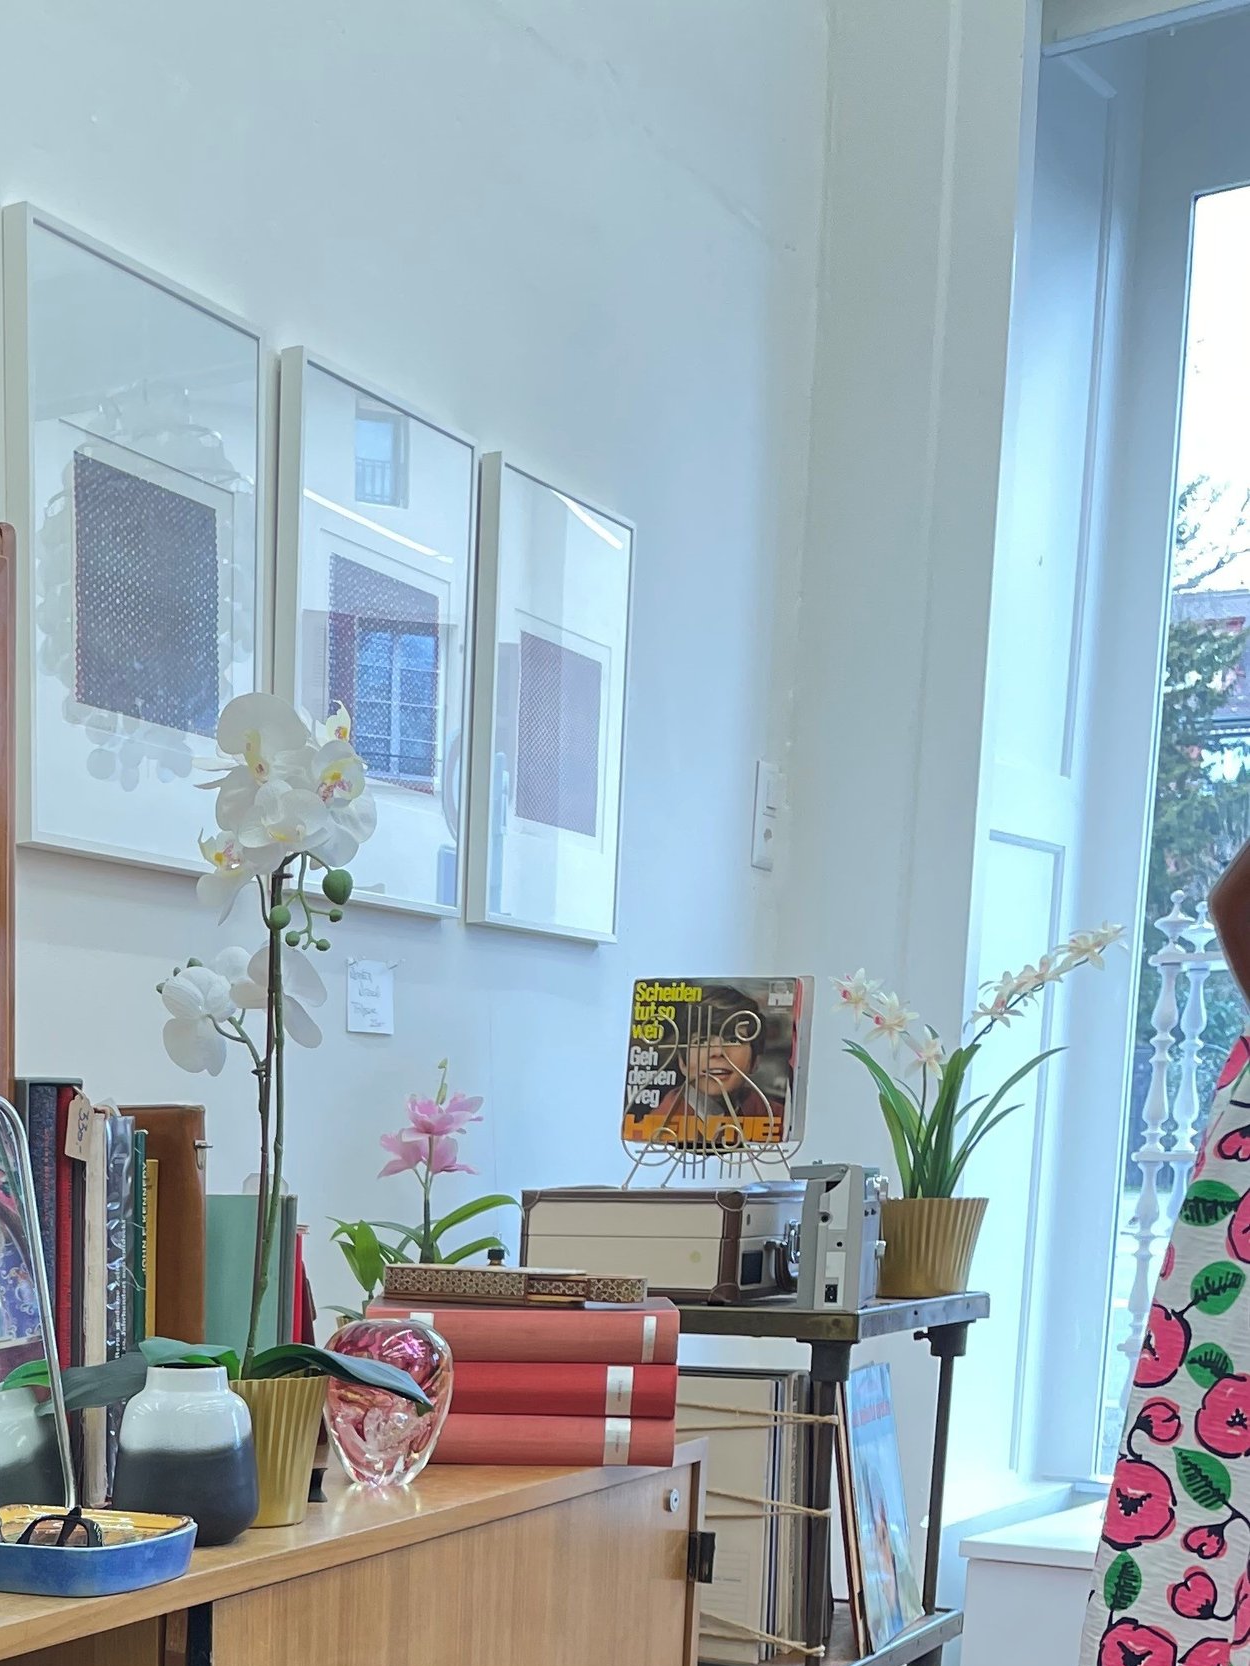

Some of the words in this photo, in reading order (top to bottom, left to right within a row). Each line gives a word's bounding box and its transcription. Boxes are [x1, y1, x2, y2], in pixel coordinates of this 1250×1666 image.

[635, 982, 702, 1003] Scheiden
[629, 1045, 659, 1066] Geh
[628, 1067, 677, 1086] deinen
[627, 1085, 661, 1108] Weg
